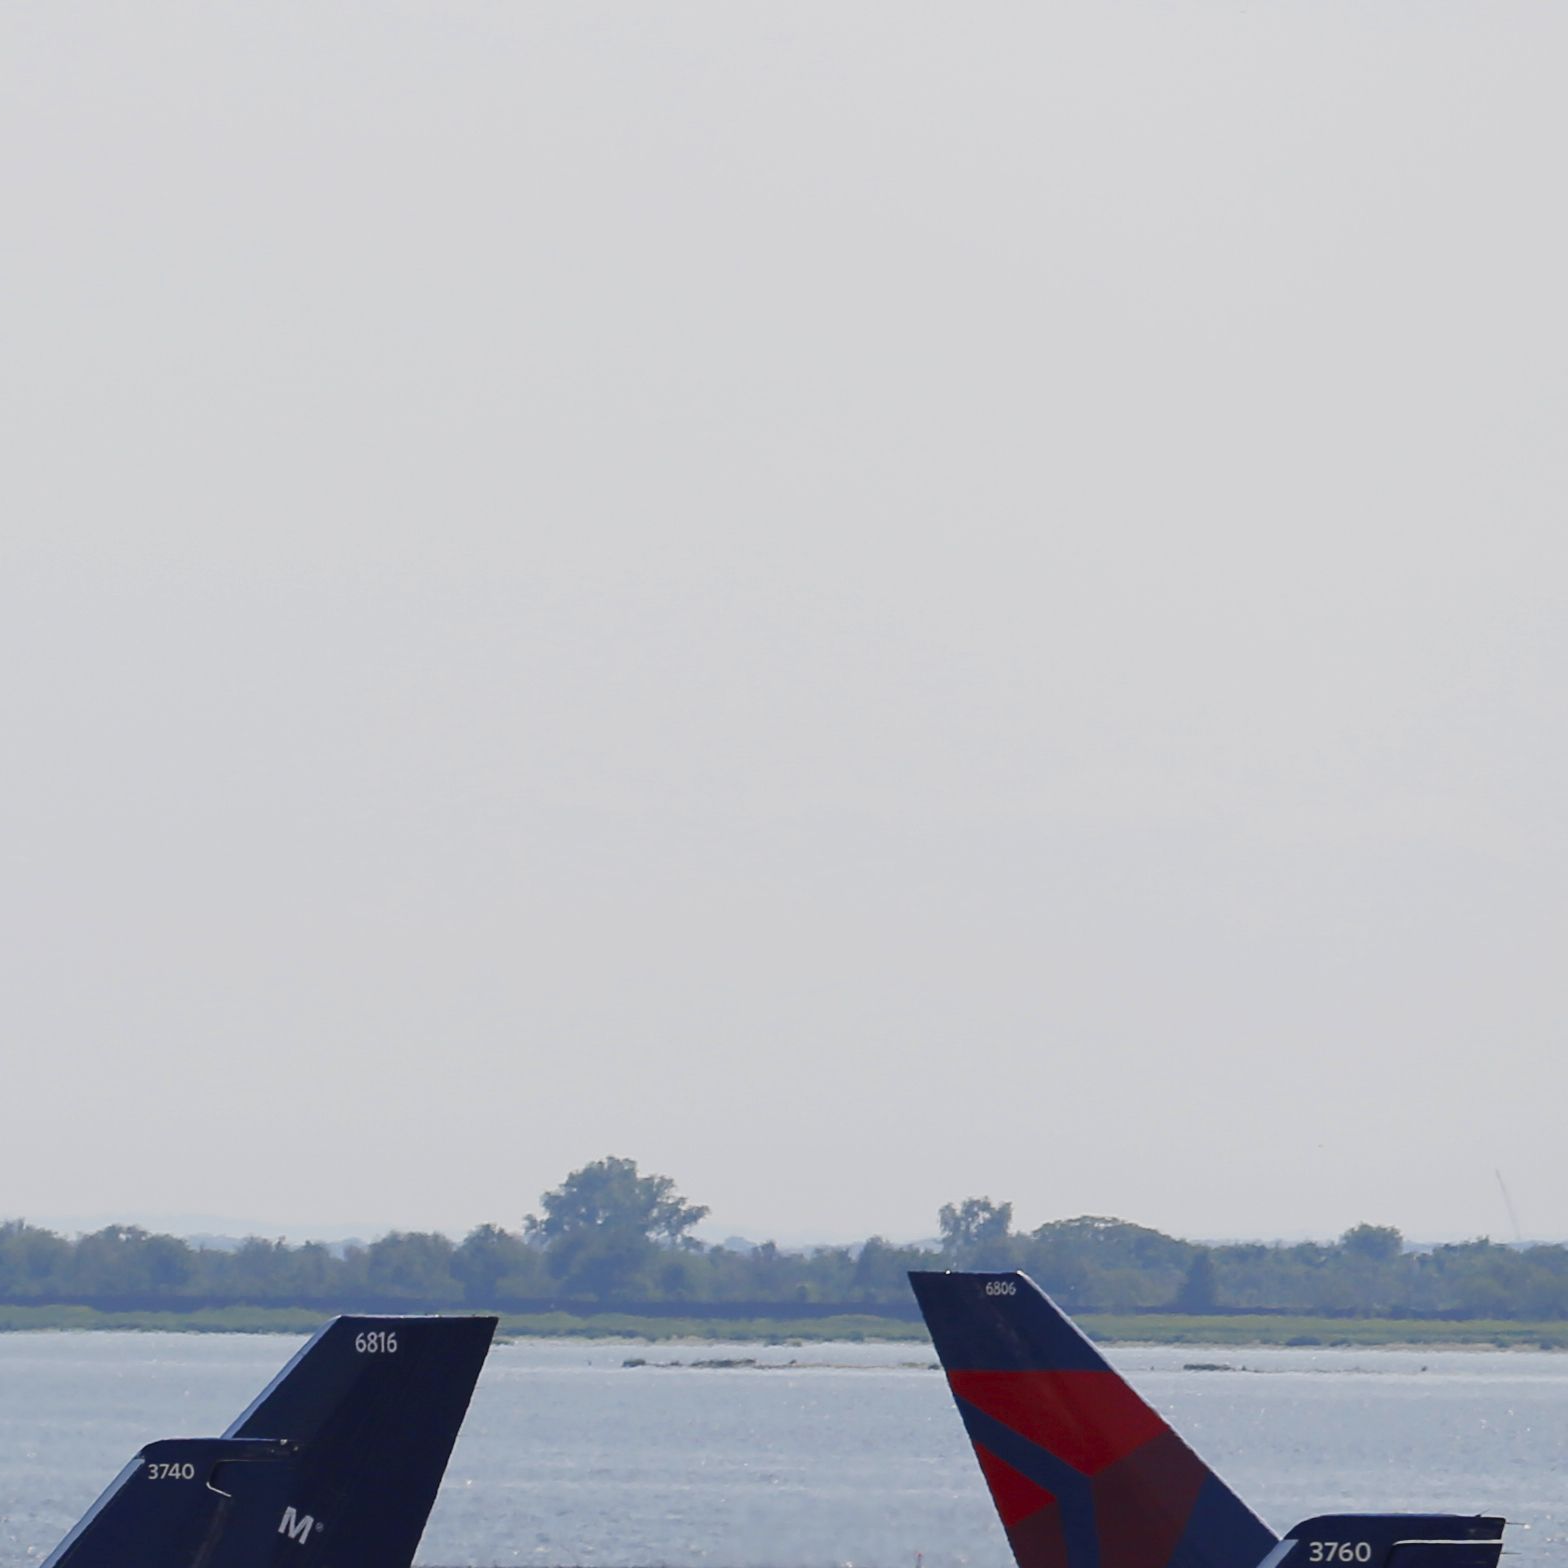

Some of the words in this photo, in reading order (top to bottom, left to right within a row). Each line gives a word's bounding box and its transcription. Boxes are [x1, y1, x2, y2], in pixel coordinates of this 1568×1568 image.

[985, 1281, 1016, 1296] 6806
[355, 1331, 398, 1353] 6816
[148, 1462, 195, 1480] 3740
[1308, 1541, 1371, 1562] 3760
